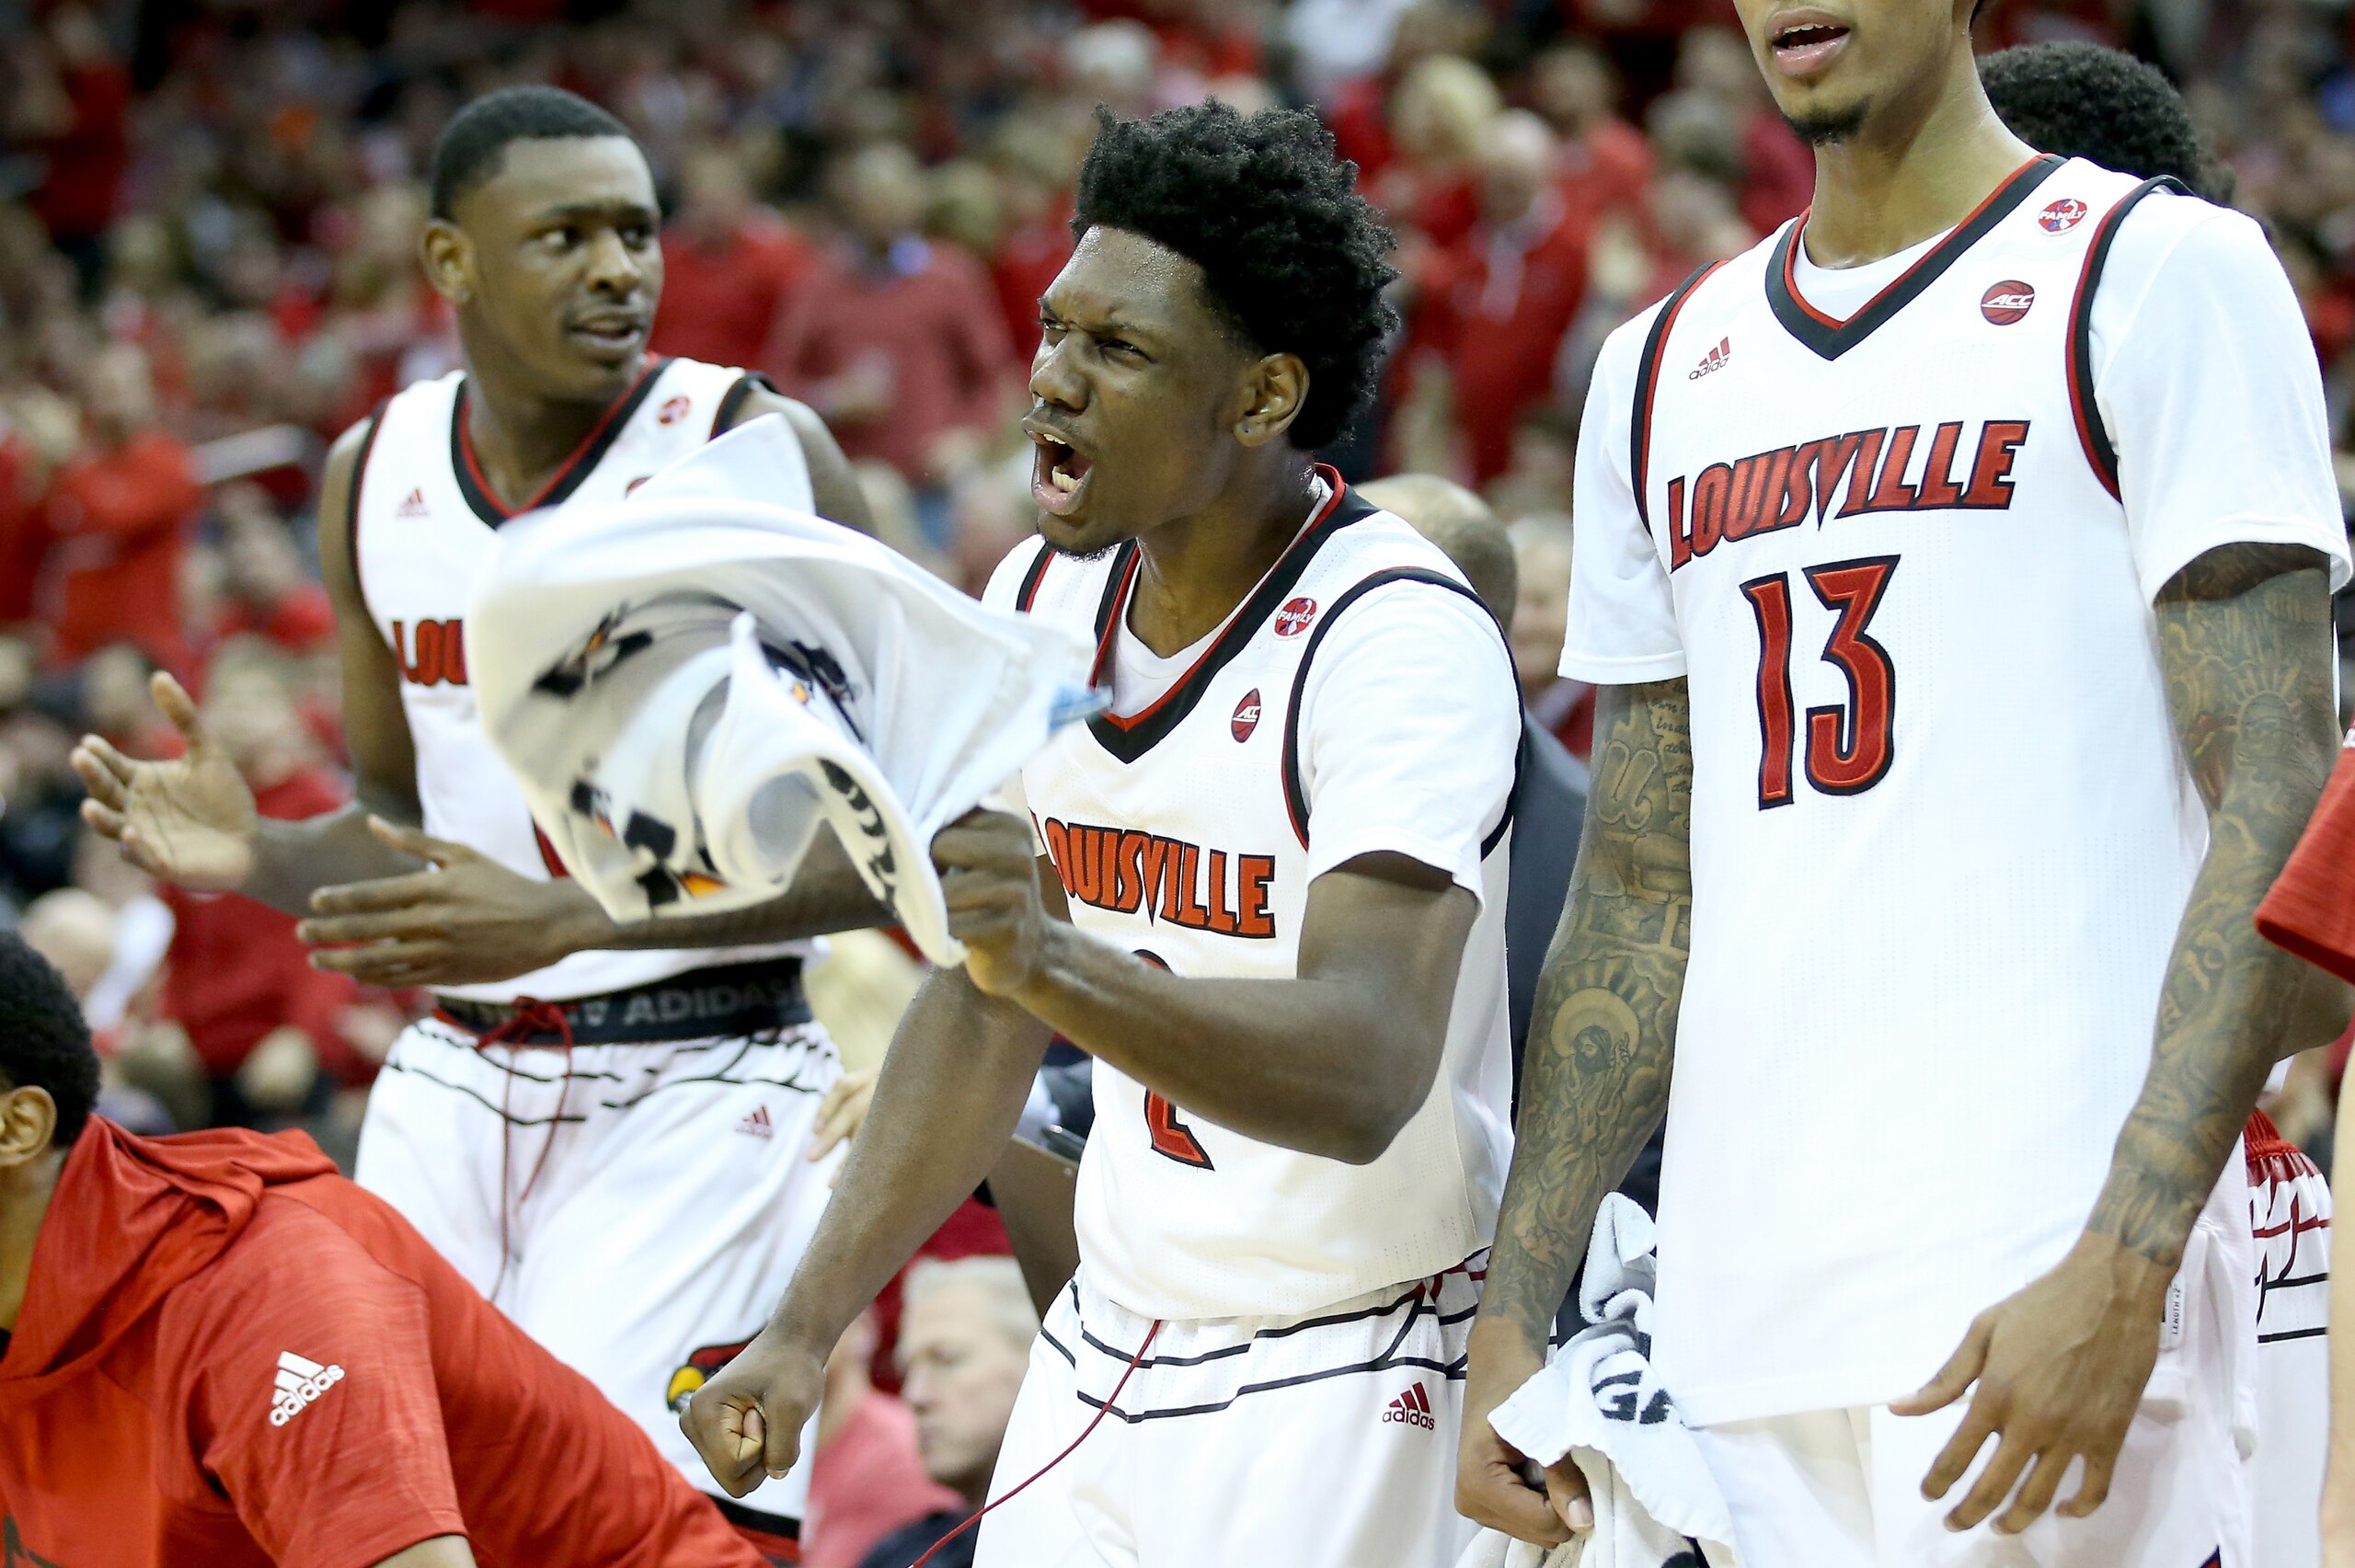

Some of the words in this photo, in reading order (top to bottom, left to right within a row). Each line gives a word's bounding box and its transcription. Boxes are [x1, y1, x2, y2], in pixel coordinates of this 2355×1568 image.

[2039, 209, 2087, 221] FAMILY
[1986, 293, 2035, 307] ACC
[1688, 356, 1730, 381] adida
[1667, 419, 2031, 574] LOUISVILLE
[1277, 610, 1315, 624] FAMILY
[1739, 554, 1901, 811] 13
[1235, 704, 1261, 719] ACC
[1028, 807, 1276, 938] OUISVILLE
[269, 1363, 347, 1428] adidas
[1382, 1407, 1435, 1431] adidas
